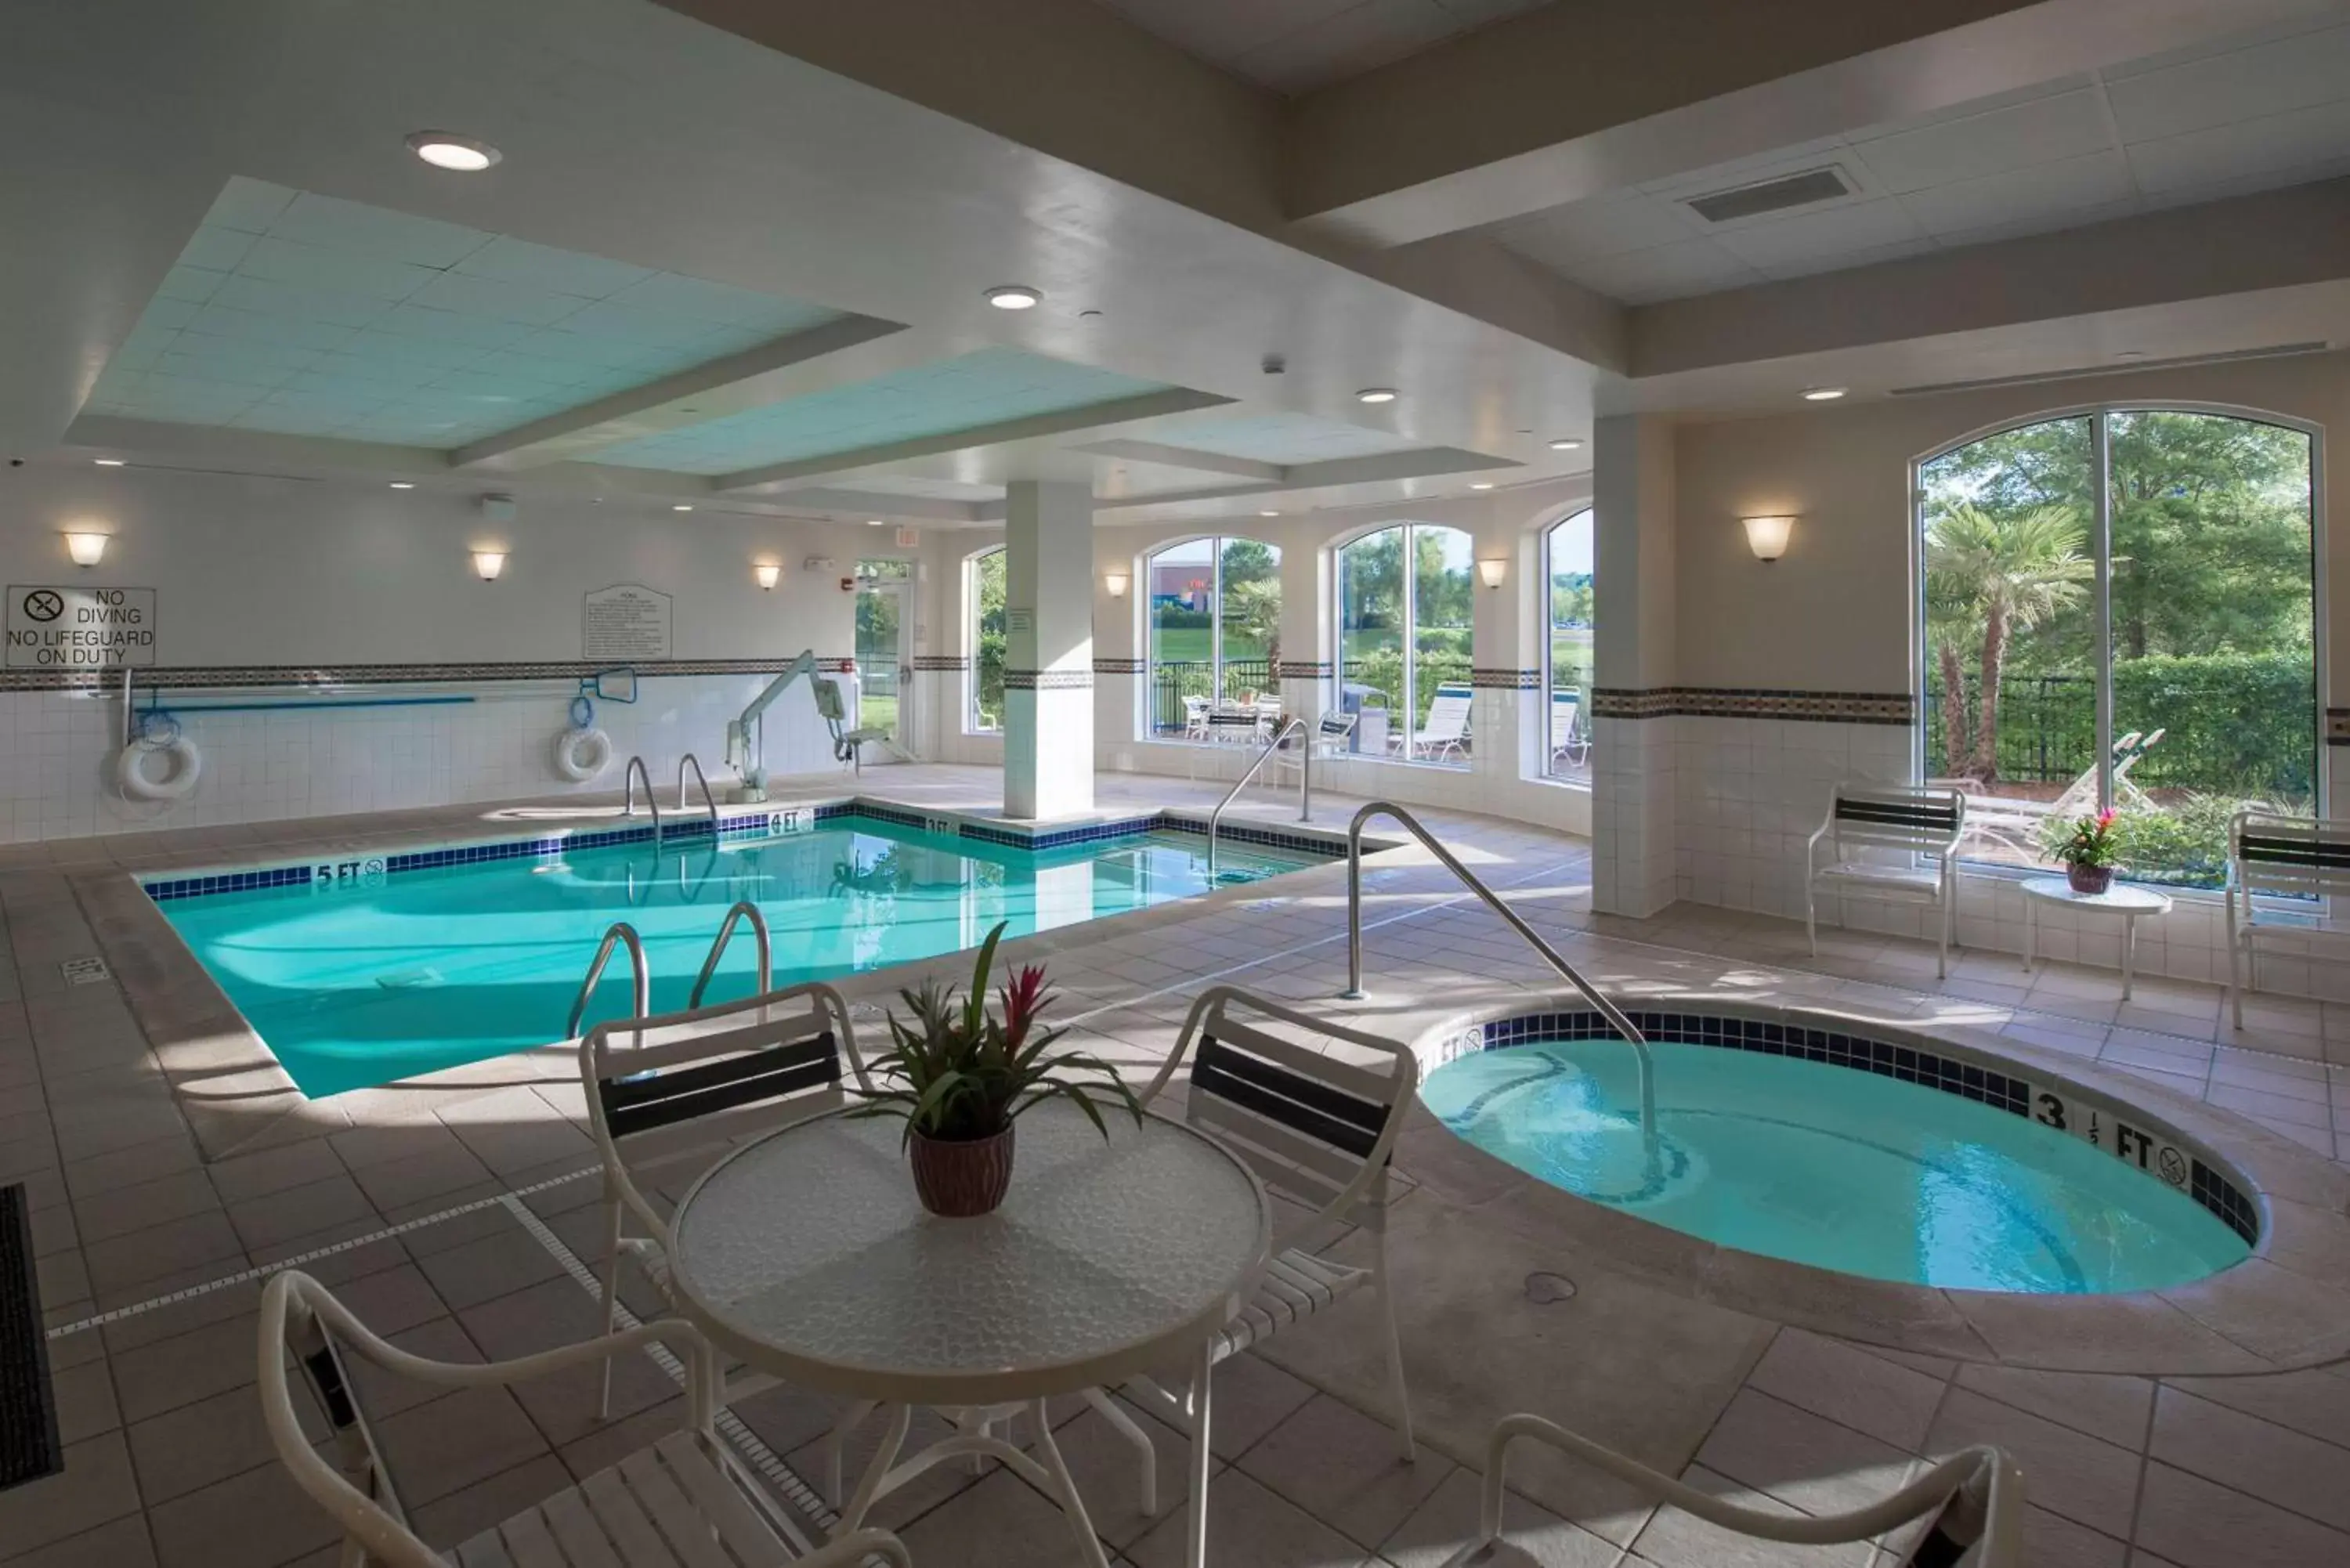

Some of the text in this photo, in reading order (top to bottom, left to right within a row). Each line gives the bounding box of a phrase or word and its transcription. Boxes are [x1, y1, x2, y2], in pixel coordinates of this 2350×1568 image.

[96, 590, 125, 605] NO
[78, 608, 142, 624] DIVING
[8, 630, 153, 647] NO LIFEGUARD
[37, 648, 126, 665] ON DUTY
[771, 811, 798, 826] 4 FT
[317, 862, 360, 881] 5 FT
[2037, 1093, 2066, 1129] 3
[2117, 1122, 2153, 1169] FT
